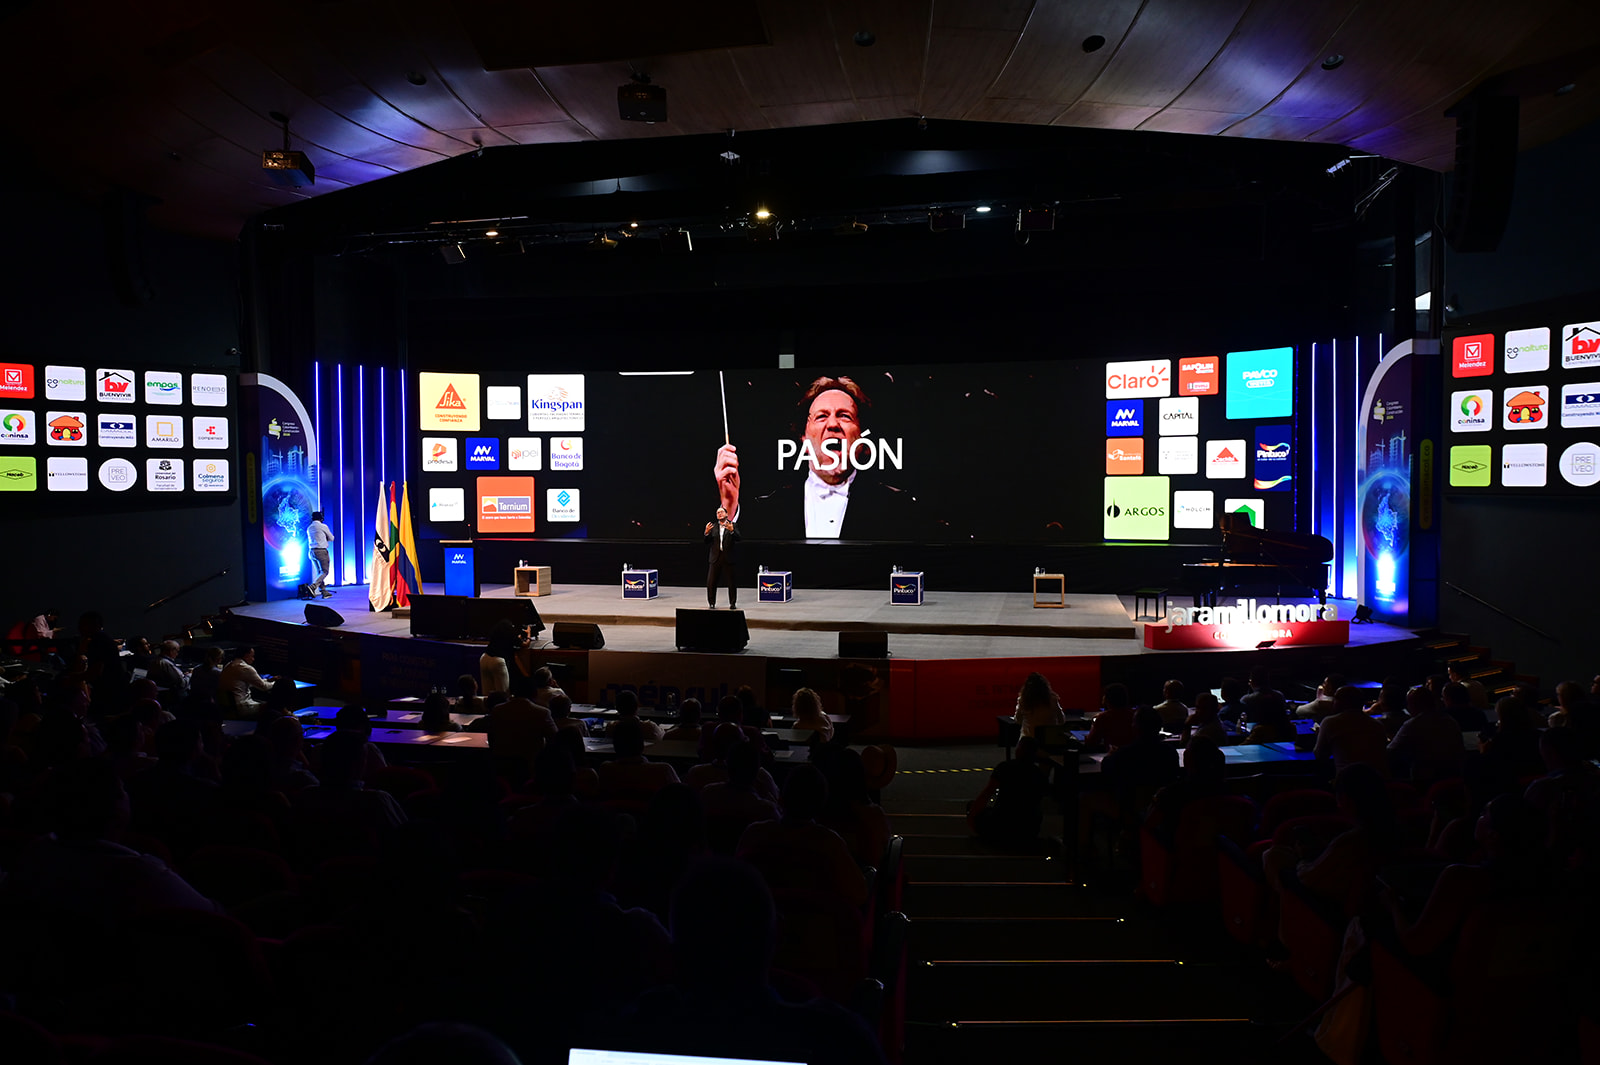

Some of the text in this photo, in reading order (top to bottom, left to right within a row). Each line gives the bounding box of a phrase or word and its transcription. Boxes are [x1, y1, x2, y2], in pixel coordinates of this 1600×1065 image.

[1242, 369, 1278, 380] PAVCO
[1107, 375, 1160, 390] Claro
[439, 392, 462, 407] Sika
[531, 399, 583, 412] Kingspan
[1162, 413, 1195, 421] CAPITAL
[777, 429, 903, 471] PASIÓN
[498, 502, 528, 511] Ternium
[1124, 507, 1166, 517] ARGOS
[1164, 598, 1339, 634] jaramillomora
